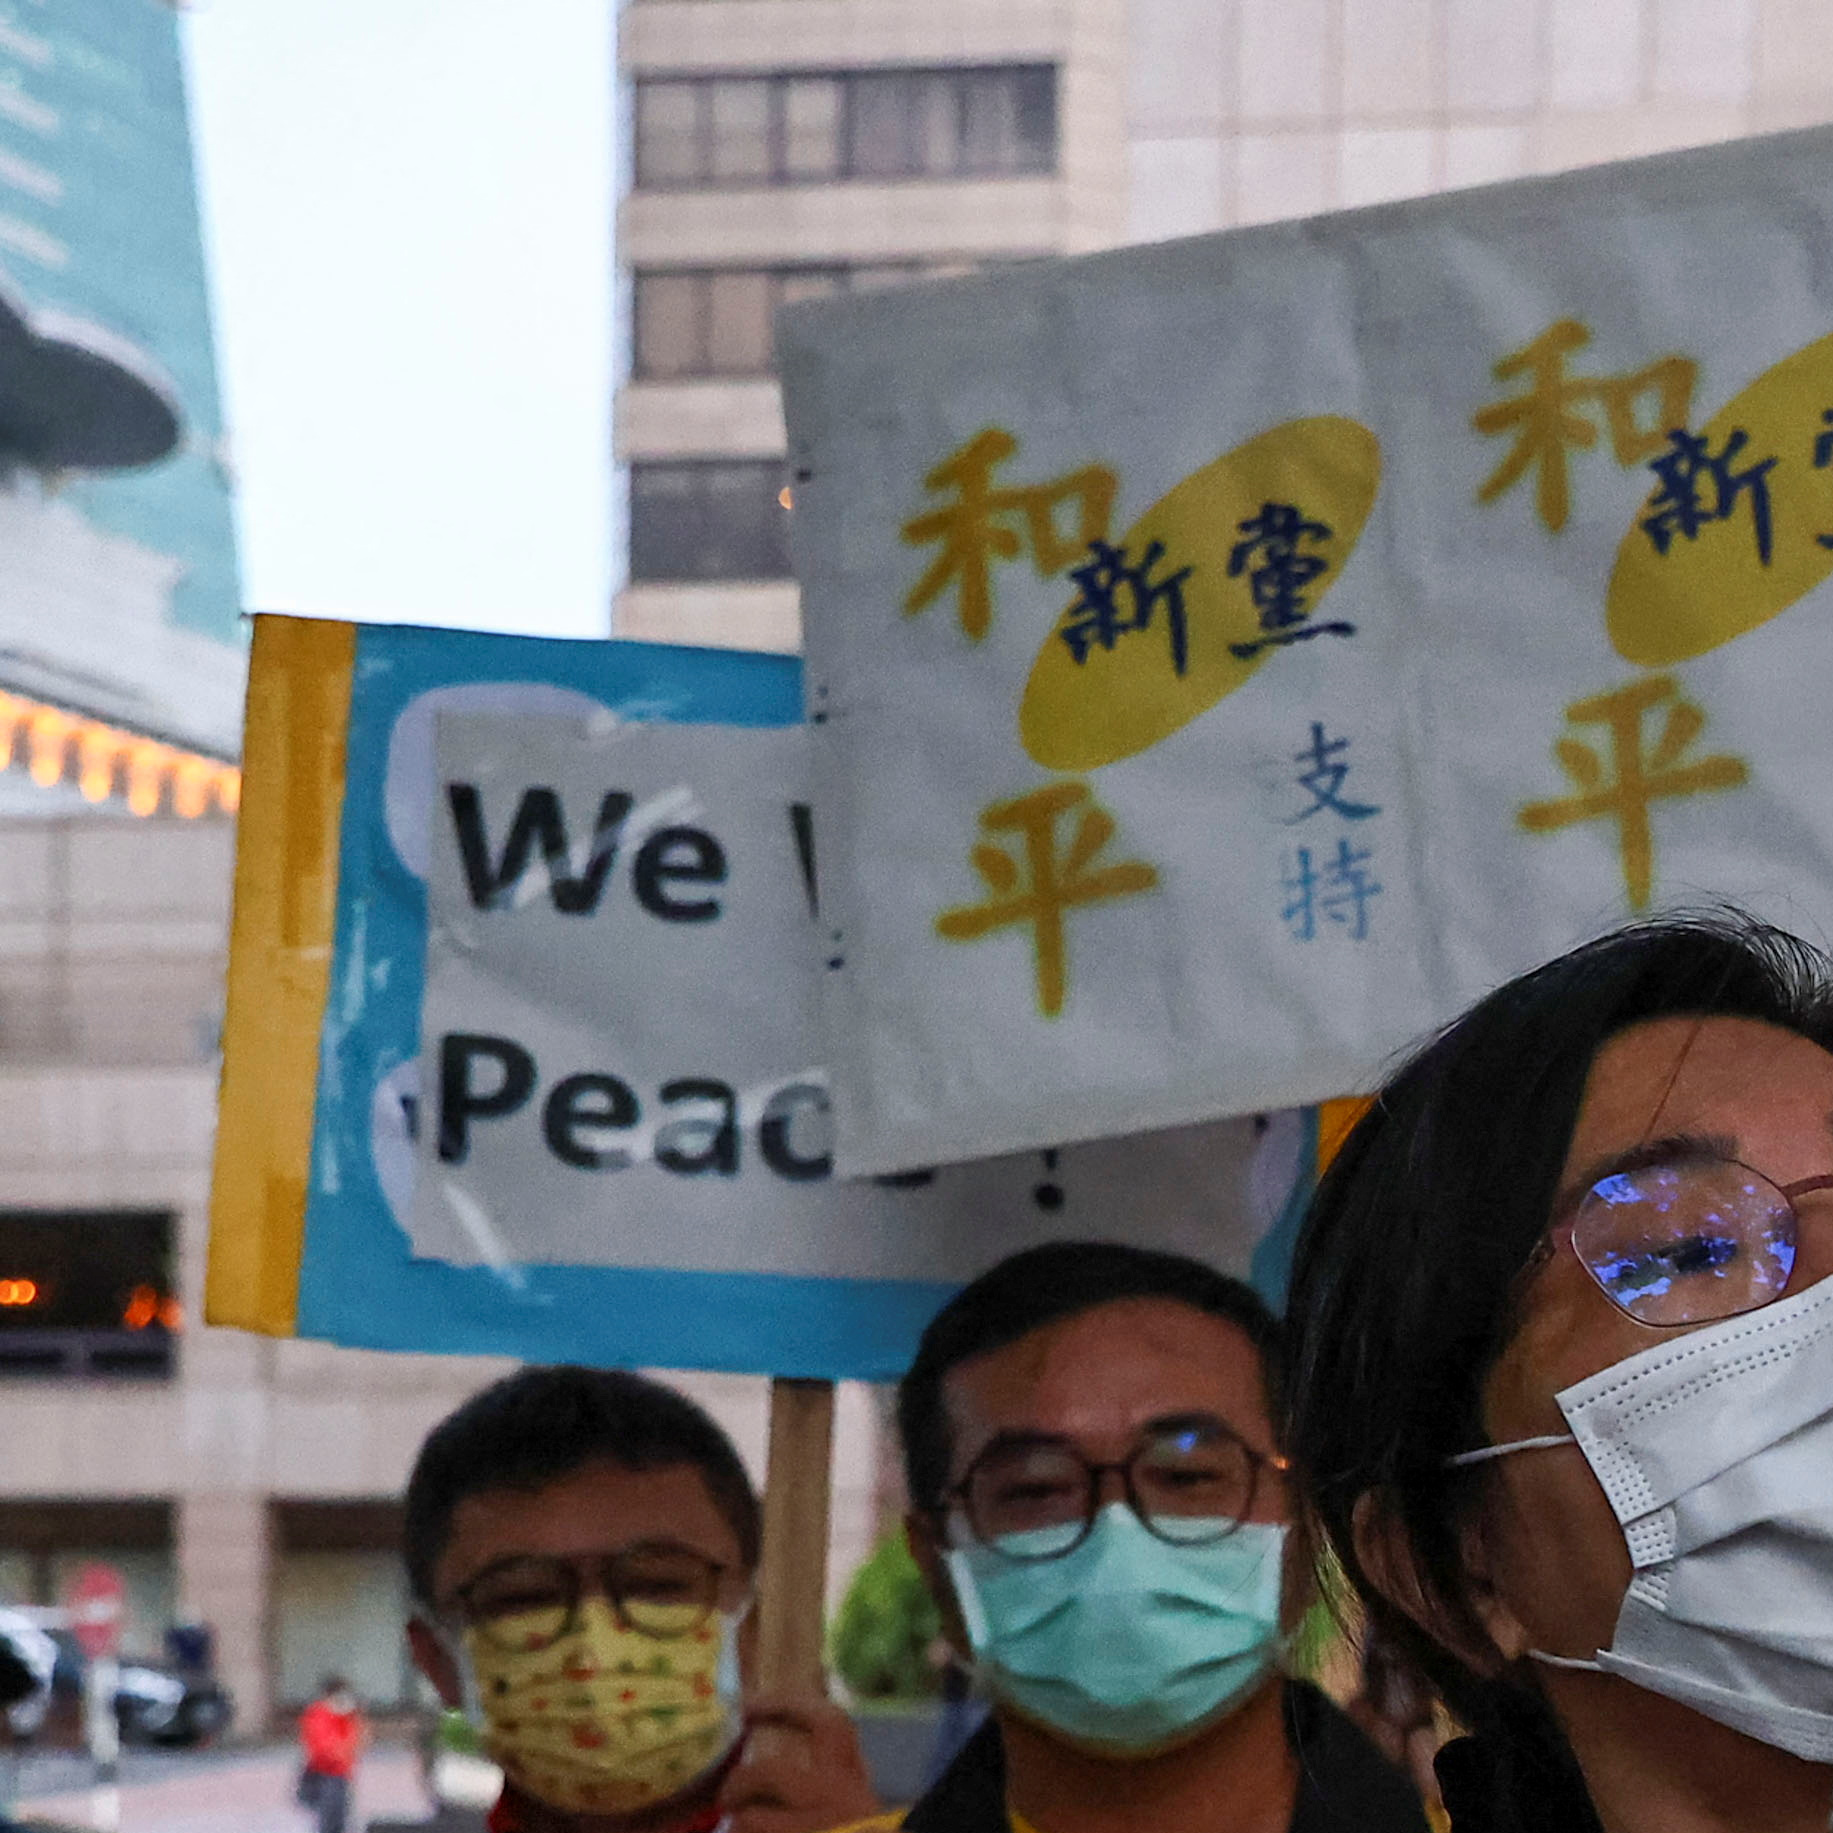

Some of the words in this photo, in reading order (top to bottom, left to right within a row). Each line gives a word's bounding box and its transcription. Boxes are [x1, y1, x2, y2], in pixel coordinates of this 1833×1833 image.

[1062, 503, 1359, 680] 新黨
[1472, 318, 1752, 915] 和平
[900, 428, 1160, 1018] 和平
[448, 780, 728, 922] We
[1278, 722, 1384, 943] 支持
[437, 1033, 935, 1189] Peac
